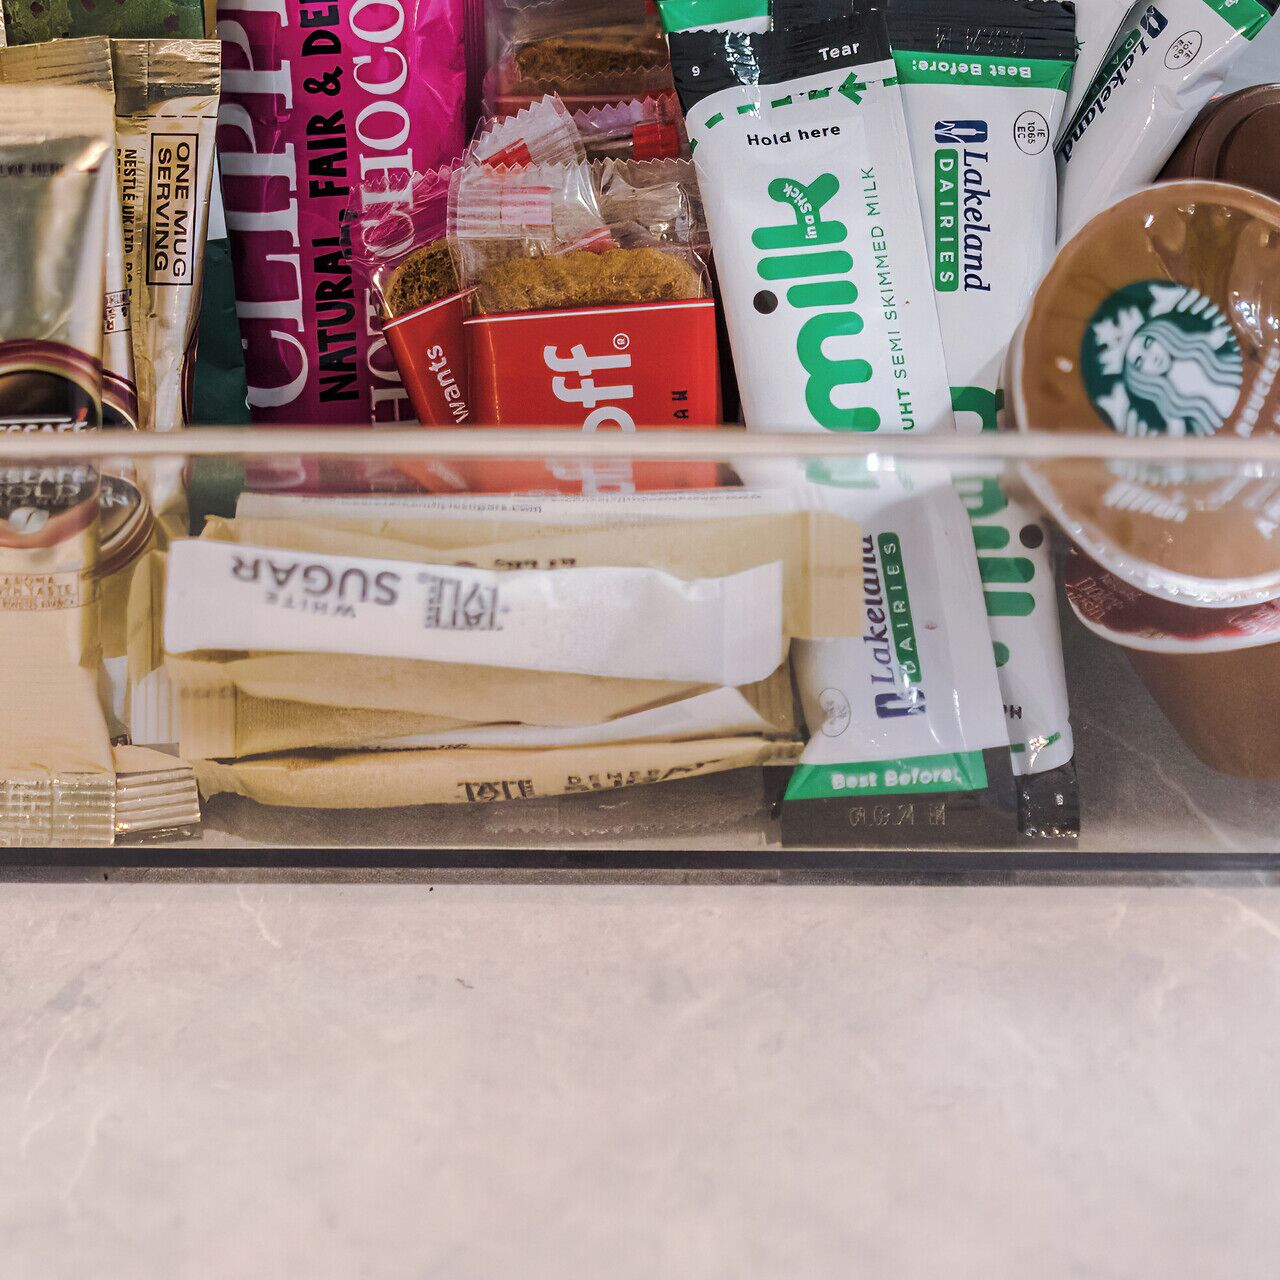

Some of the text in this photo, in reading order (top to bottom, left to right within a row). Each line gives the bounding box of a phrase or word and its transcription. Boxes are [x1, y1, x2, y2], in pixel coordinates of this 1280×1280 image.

[303, 62, 344, 98] &
[691, 65, 701, 77] 9
[818, 41, 861, 62] Tear
[988, 64, 1032, 79] Best
[1016, 125, 1026, 139] EC
[1061, 36, 1150, 163] Lakeland
[308, 107, 349, 200] FAIR
[746, 124, 842, 147] Hold here
[1026, 121, 1036, 145] 1065
[153, 147, 173, 272] SERVING
[172, 141, 191, 279] ONE MUG
[939, 157, 955, 283] DAIRIES
[963, 148, 991, 292] Lakeland
[751, 172, 882, 433] milk
[859, 166, 916, 432] UHT SEMI SKIMMED MILK
[426, 344, 470, 424] wants
[230, 555, 401, 607] SUGAR
[264, 590, 356, 619] WHITE
[882, 541, 920, 677] DAIRIES
[830, 767, 879, 791] Best
